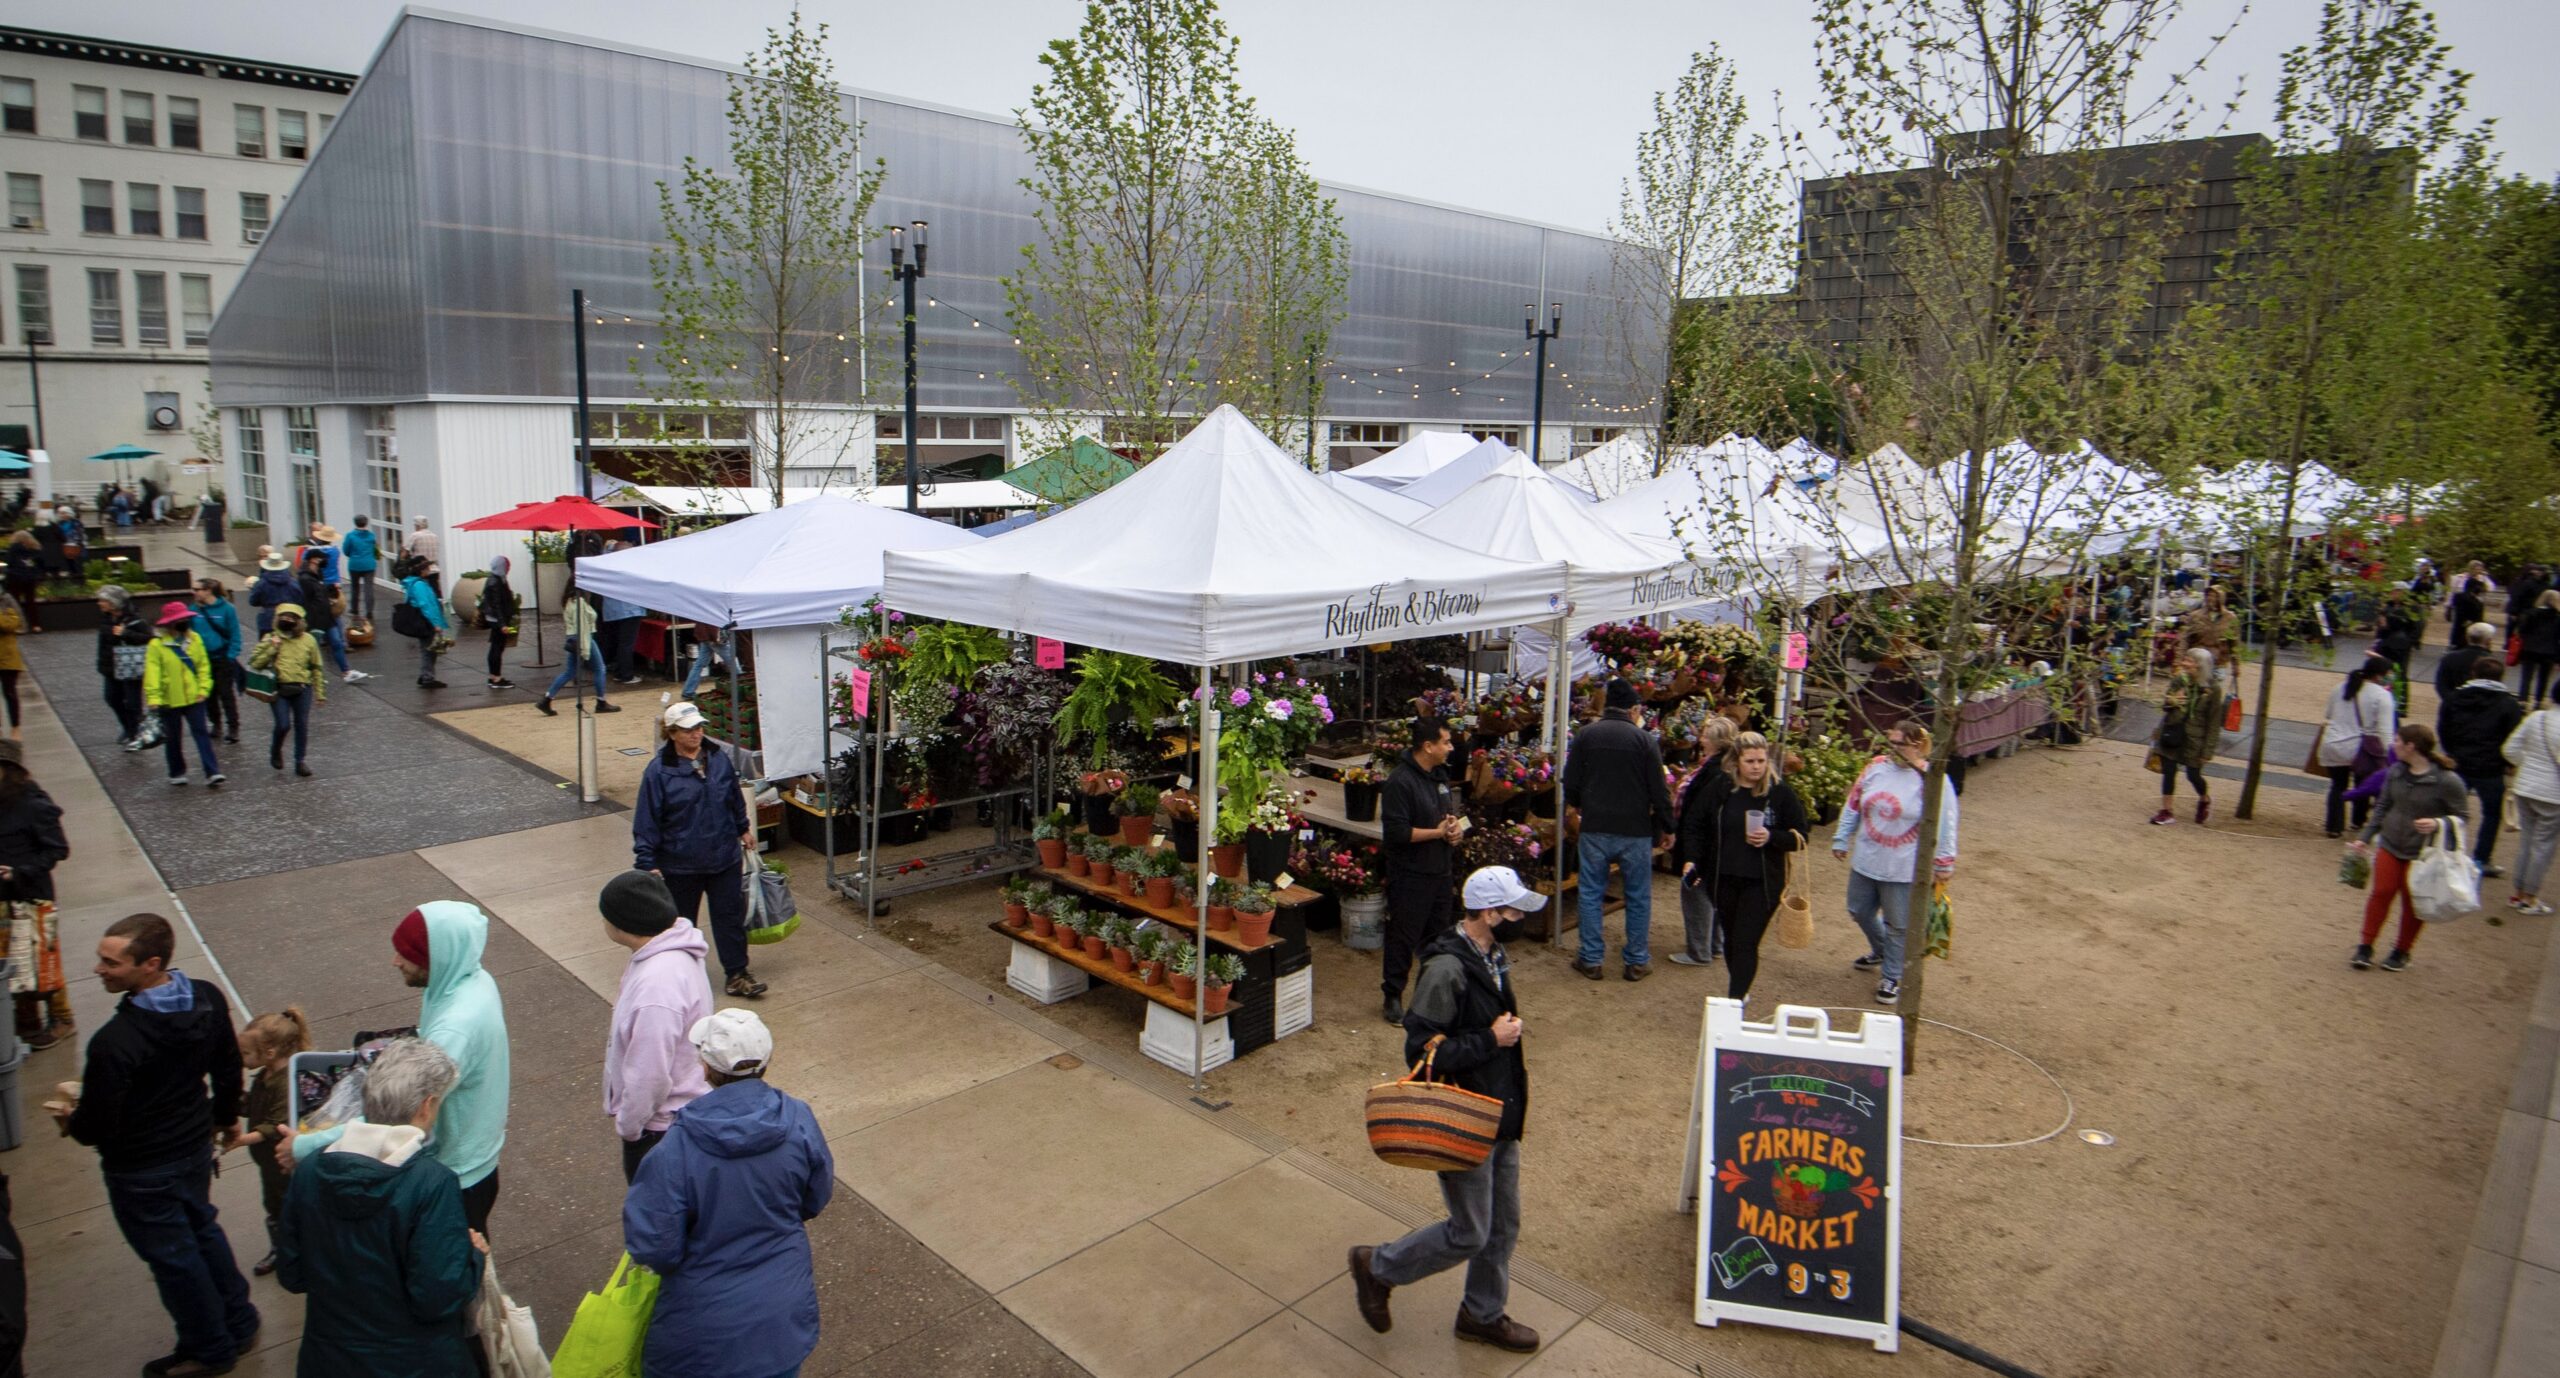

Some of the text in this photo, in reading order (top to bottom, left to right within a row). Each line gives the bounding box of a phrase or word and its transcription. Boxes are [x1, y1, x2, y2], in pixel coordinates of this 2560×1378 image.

[1631, 561, 1685, 610] Rhythm
[1688, 568, 1701, 597] &
[1325, 582, 1487, 643] Rhythm & Blooms
[1770, 1076, 1826, 1095] WELCOME
[1780, 1090, 1796, 1105] TO
[1738, 1127, 1866, 1177] FARMERS
[1737, 1197, 1859, 1251] MARKET
[1787, 1262, 1808, 1294] 9
[1829, 1268, 1851, 1301] 3
